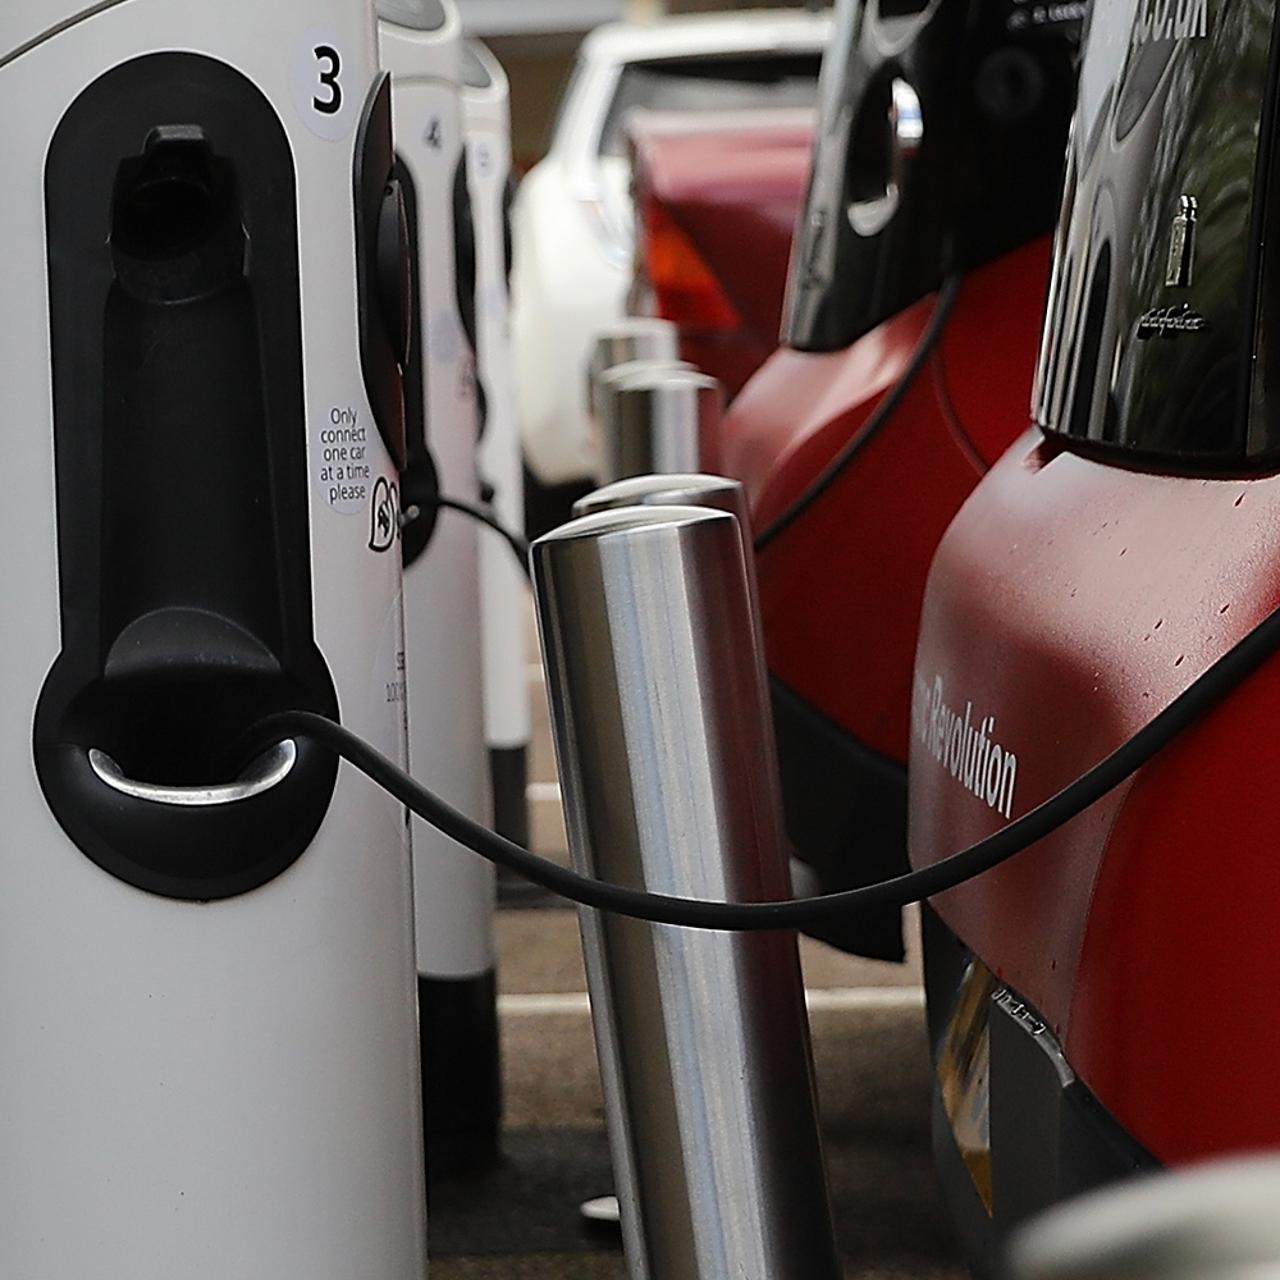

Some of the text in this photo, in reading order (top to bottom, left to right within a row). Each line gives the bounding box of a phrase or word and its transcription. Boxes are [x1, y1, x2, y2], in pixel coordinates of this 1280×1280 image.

[313, 45, 342, 114] 3
[330, 406, 358, 429] Only
[320, 425, 366, 444] connect
[323, 446, 367, 462] one car
[320, 462, 370, 482] at a time
[329, 483, 367, 505] please
